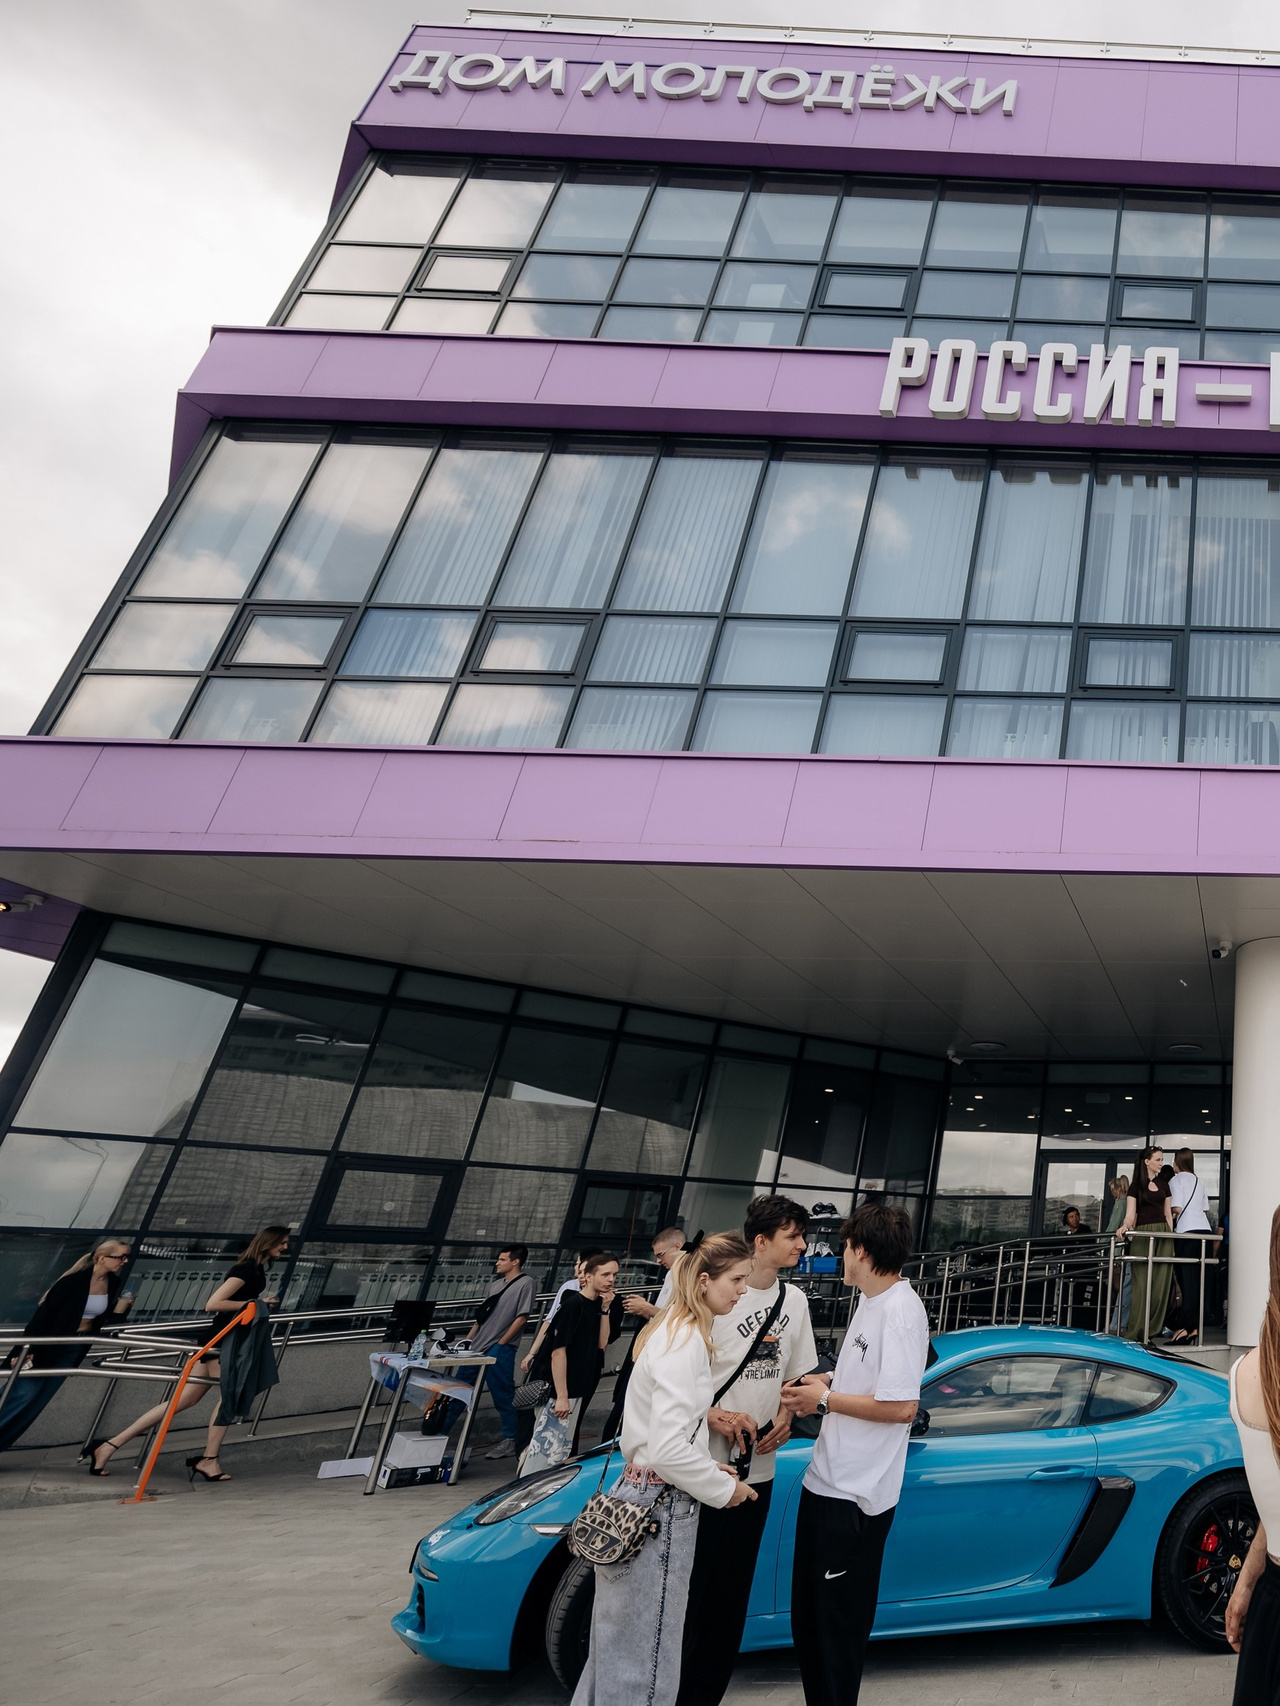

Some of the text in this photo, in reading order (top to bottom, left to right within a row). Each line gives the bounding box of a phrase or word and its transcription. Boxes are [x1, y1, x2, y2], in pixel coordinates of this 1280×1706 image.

[388, 50, 1018, 116] ДОМ МОЛОДЁЖИ
[879, 335, 1180, 429] РОССИЯ
